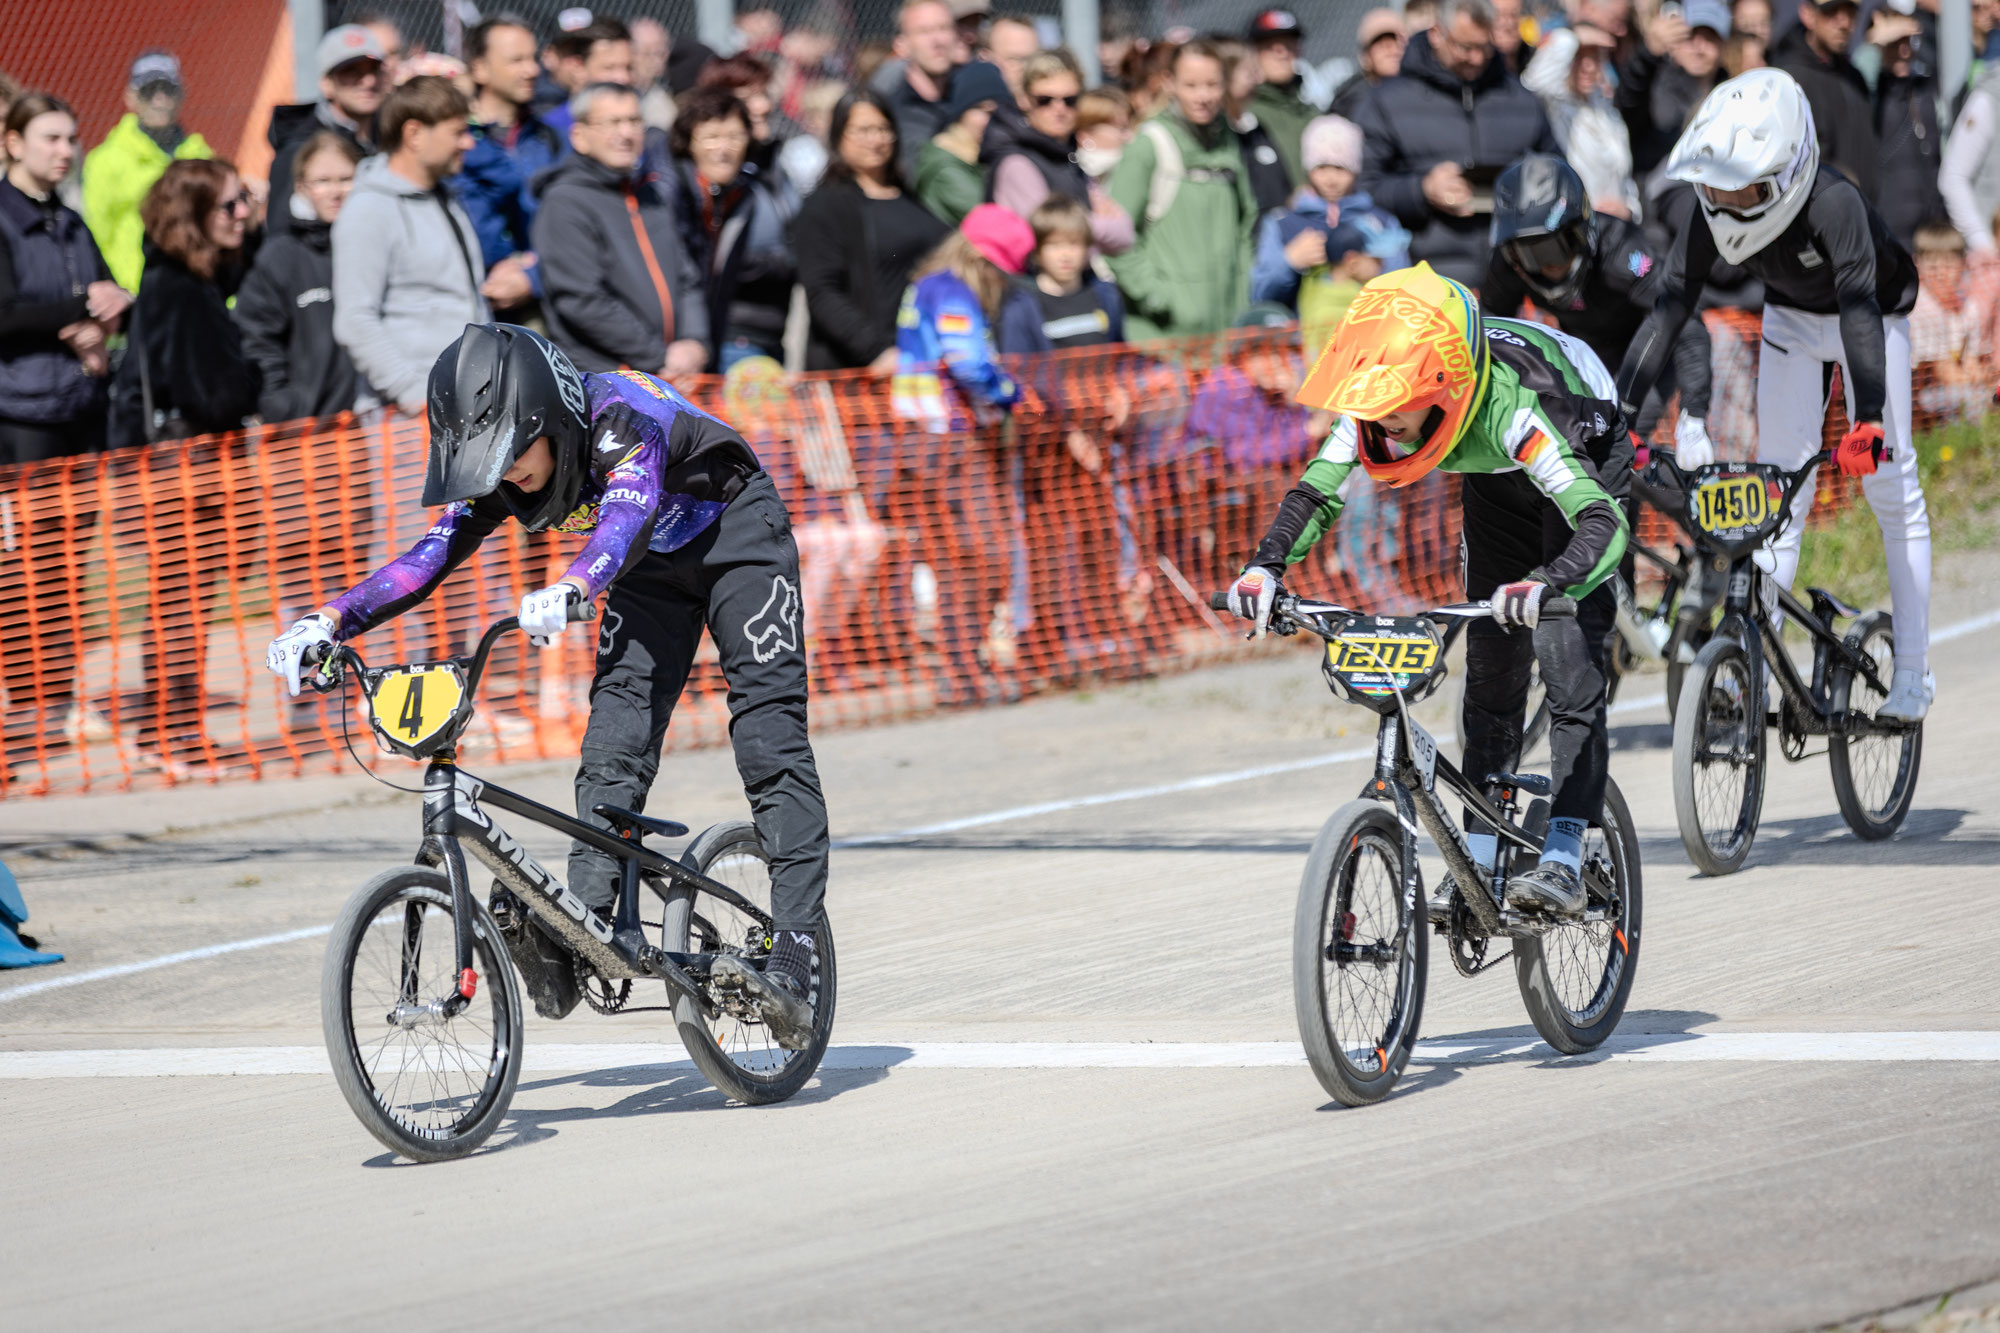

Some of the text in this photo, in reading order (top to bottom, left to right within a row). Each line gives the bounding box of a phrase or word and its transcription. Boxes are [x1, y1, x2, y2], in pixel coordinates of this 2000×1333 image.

[1702, 483, 1761, 525] 1450
[1375, 616, 1396, 627] box
[409, 664, 426, 674] box
[398, 675, 424, 739] 4
[486, 819, 614, 945] MEYBO
